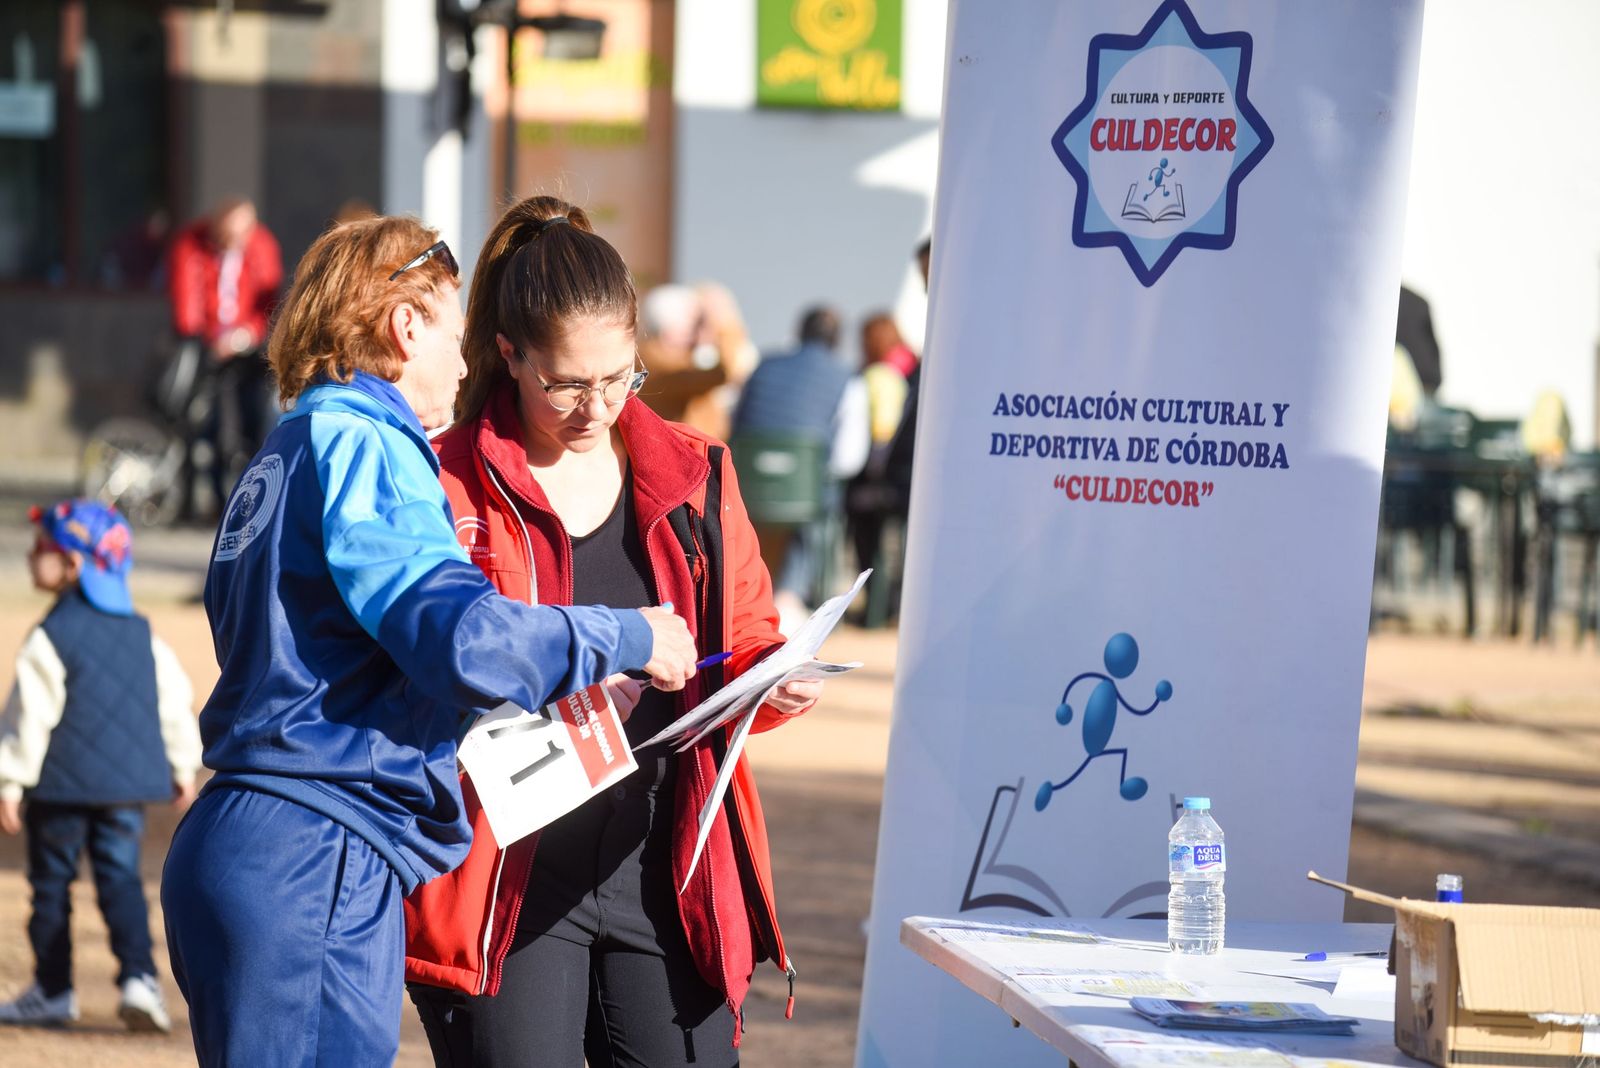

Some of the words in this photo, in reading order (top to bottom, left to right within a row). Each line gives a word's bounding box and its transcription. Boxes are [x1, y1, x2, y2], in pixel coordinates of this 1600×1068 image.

[1110, 92, 1160, 104] CULTURA
[1172, 92, 1225, 105] DEPORTE
[1089, 118, 1237, 152] CULDECOR
[992, 390, 1138, 422] ASOCIACIÓN
[1142, 398, 1267, 427] CULTURAL
[1272, 403, 1290, 427] Y
[989, 432, 1121, 462] DEPORTIVA
[1125, 436, 1160, 463] DE
[1165, 432, 1290, 469] CÓRDOBA
[567, 692, 592, 740] ULDECOR
[1196, 847, 1220, 855] AQUA
